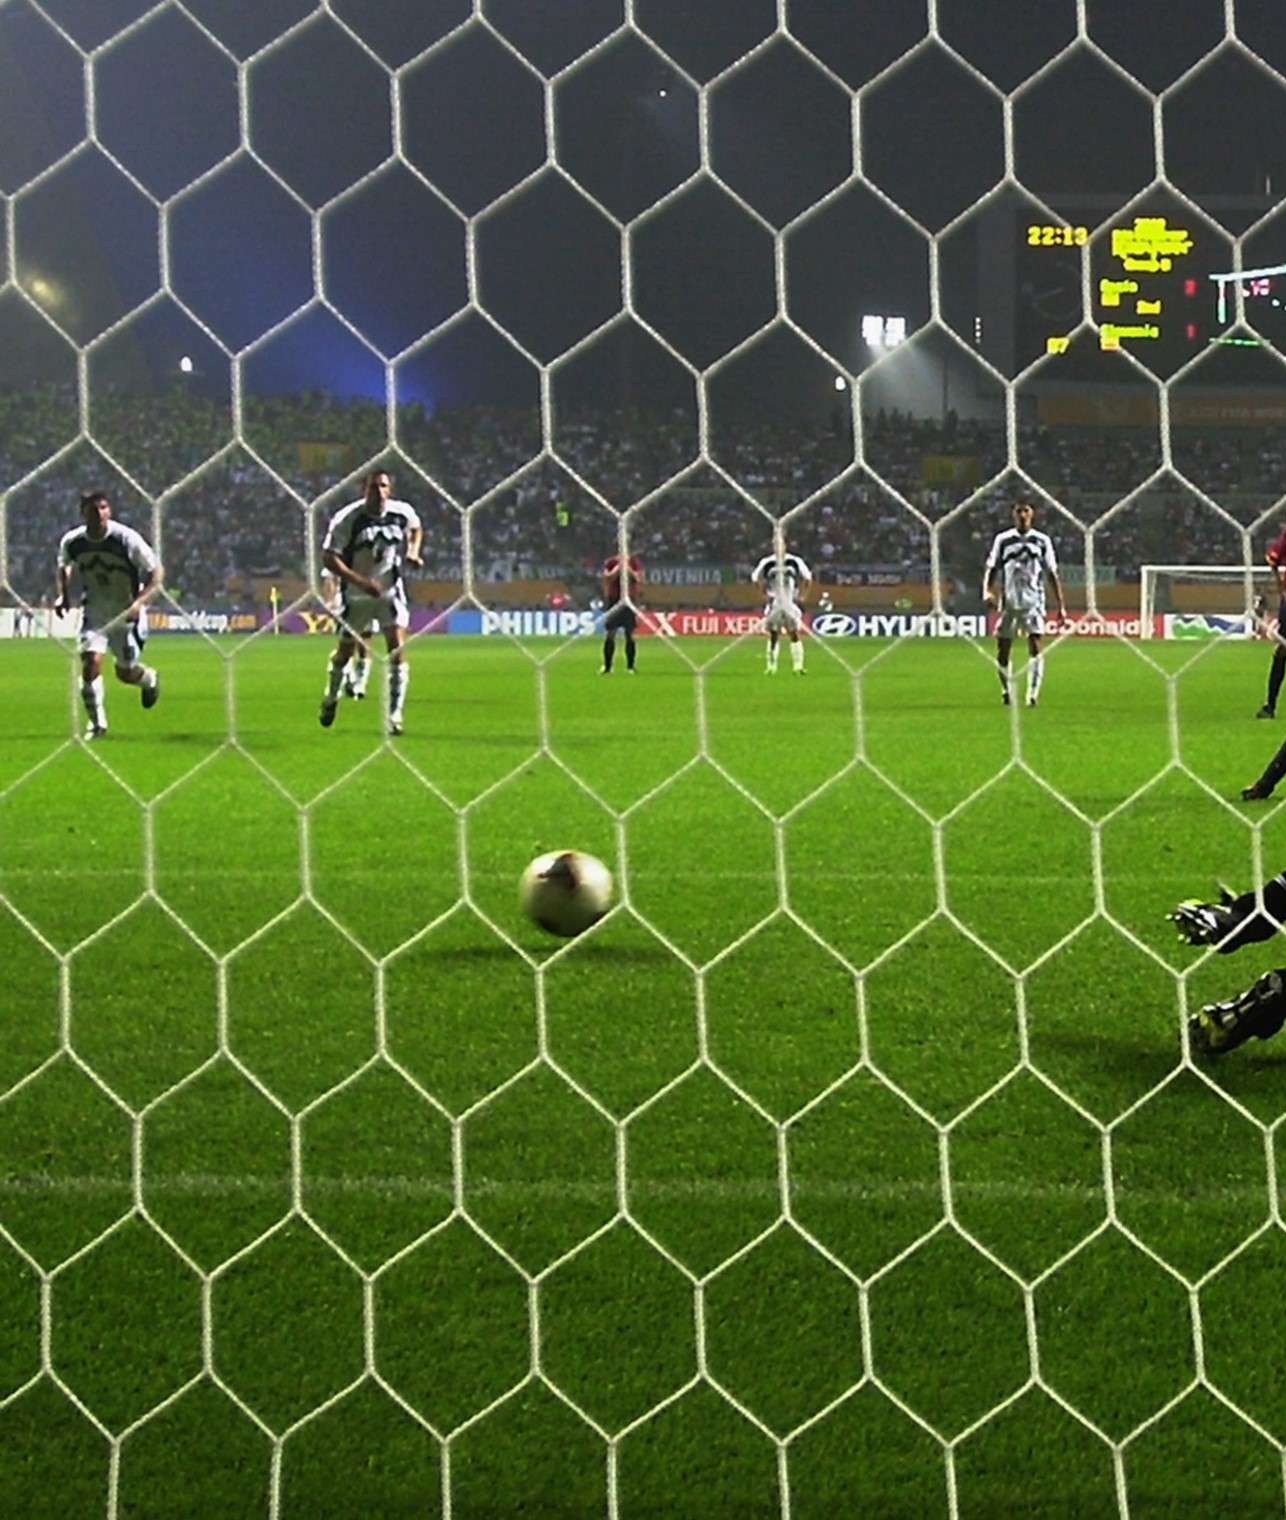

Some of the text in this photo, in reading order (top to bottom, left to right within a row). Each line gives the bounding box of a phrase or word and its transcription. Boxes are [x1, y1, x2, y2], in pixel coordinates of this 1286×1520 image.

[482, 611, 595, 635] PHILIPS
[684, 615, 720, 634] FUJI
[859, 615, 986, 637] HYUNDAI
